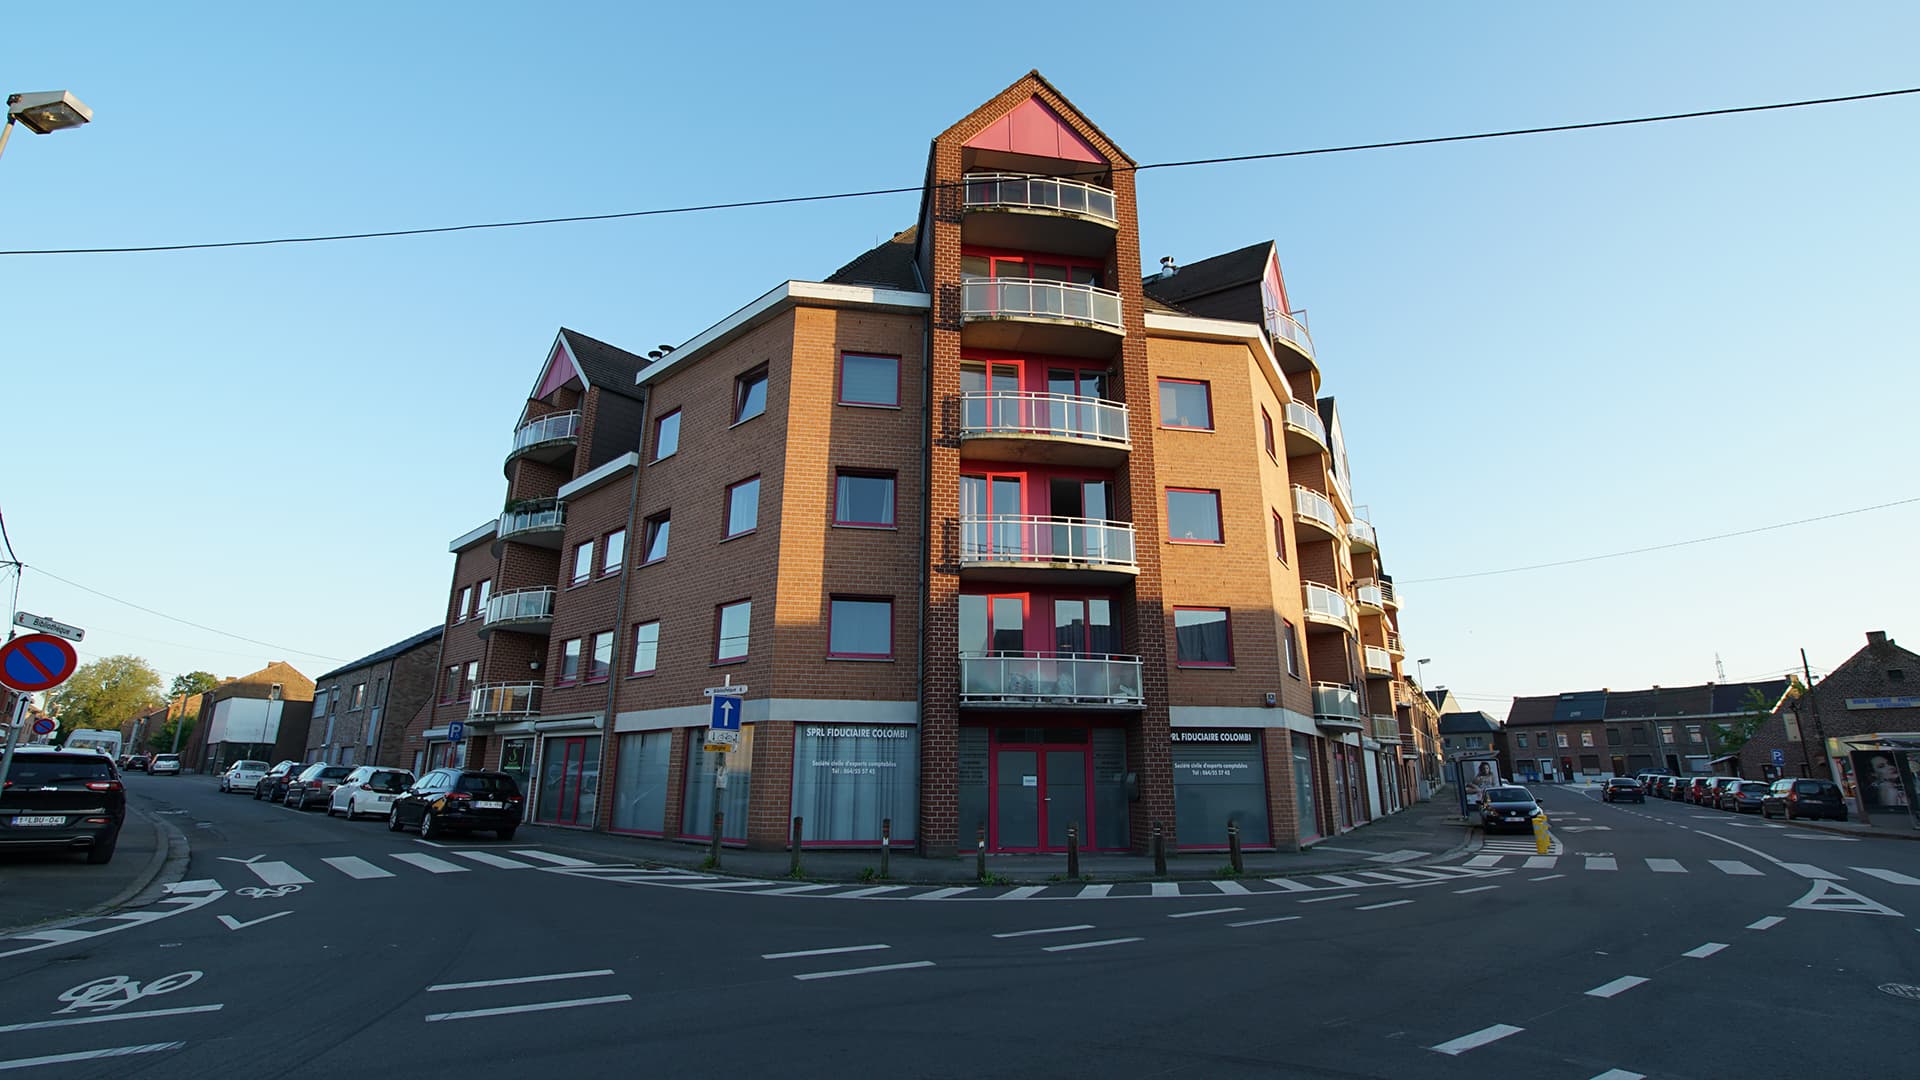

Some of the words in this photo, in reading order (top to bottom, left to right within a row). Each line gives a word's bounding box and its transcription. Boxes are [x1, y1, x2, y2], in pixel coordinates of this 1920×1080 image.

[33, 618, 72, 635] Bibliothèque
[450, 724, 461, 738] P
[806, 727, 825, 737] SPRL
[827, 728, 871, 738] FIDUCIAIRE
[872, 729, 908, 738] COLOMBI
[1181, 732, 1219, 742] FIDUCIAIRE
[1220, 732, 1252, 742] COLOMBI
